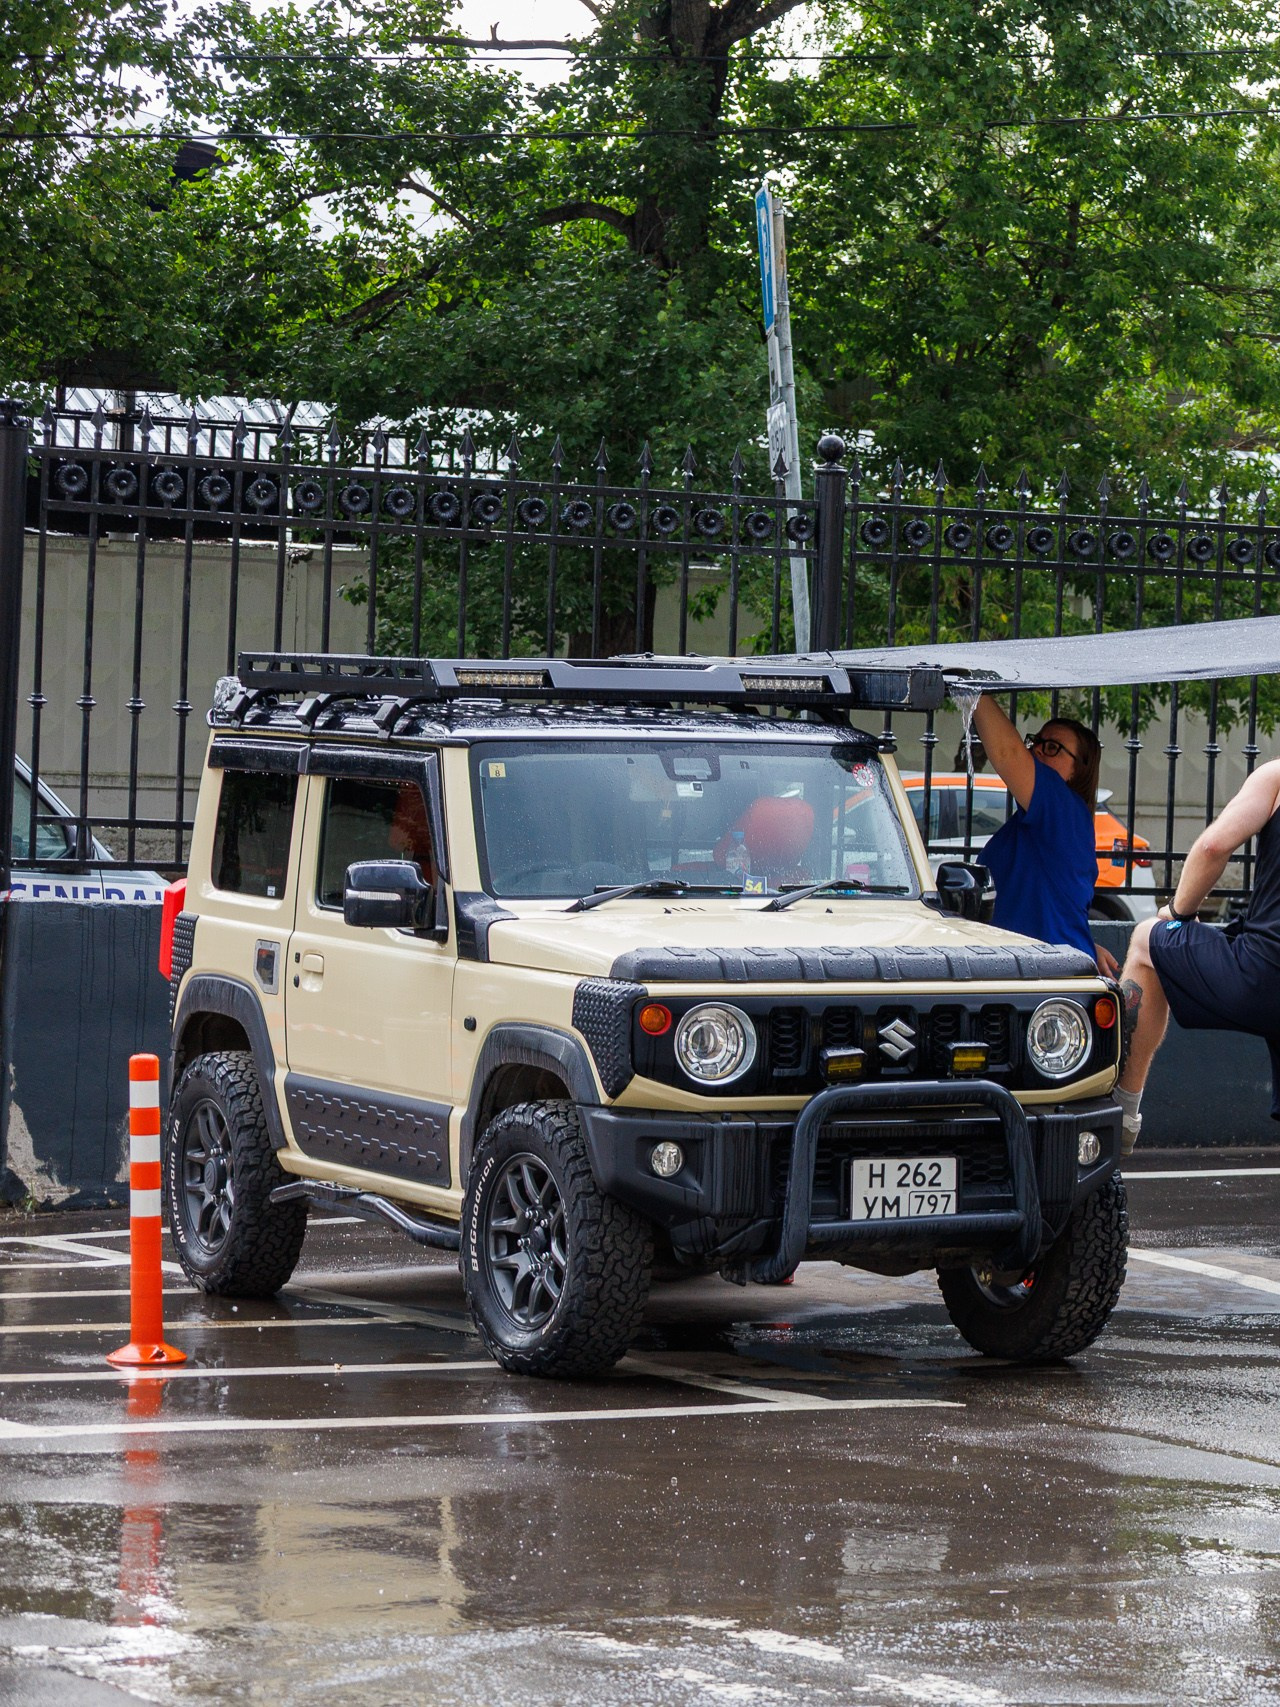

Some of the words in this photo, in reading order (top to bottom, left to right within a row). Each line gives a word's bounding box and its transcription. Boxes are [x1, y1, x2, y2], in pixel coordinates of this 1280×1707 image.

[745, 879, 763, 894] 54
[171, 1118, 181, 1144] T/A
[896, 1162, 942, 1188] 262
[470, 1156, 495, 1272] BFGoodrich
[863, 1195, 900, 1219] УМ
[914, 1194, 951, 1214] 797
